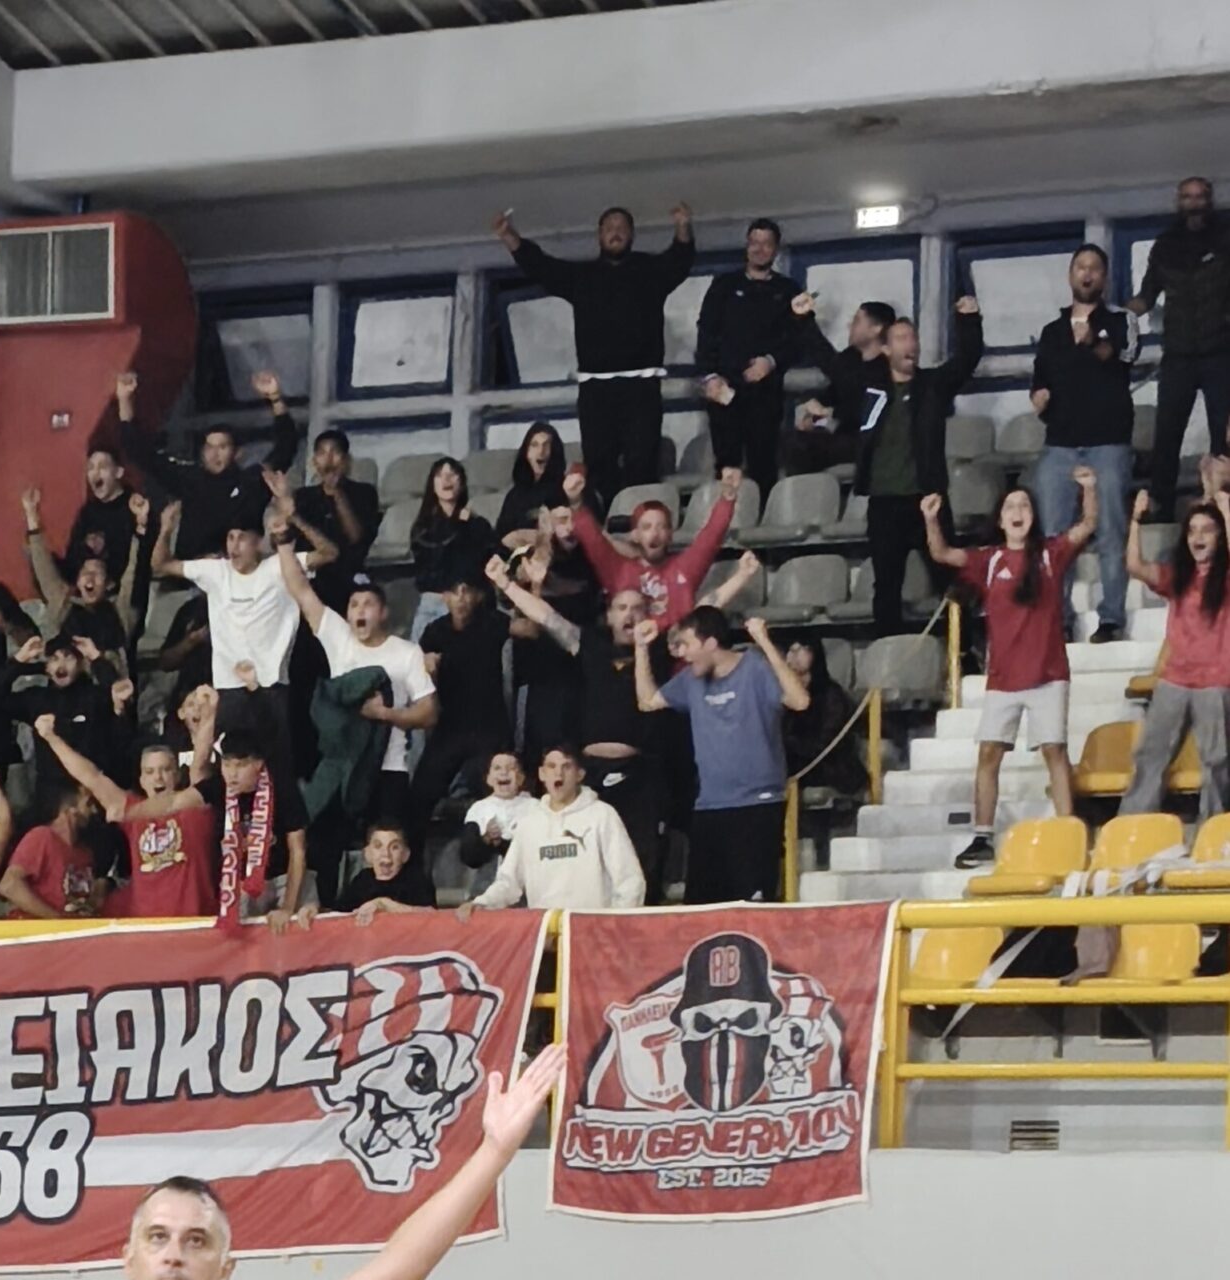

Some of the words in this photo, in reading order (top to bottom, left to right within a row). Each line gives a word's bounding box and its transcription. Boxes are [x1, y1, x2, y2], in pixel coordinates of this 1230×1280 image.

[563, 1117, 644, 1166] NEW
[658, 1168, 705, 1189] EST.
[712, 1166, 772, 1188] 2025
